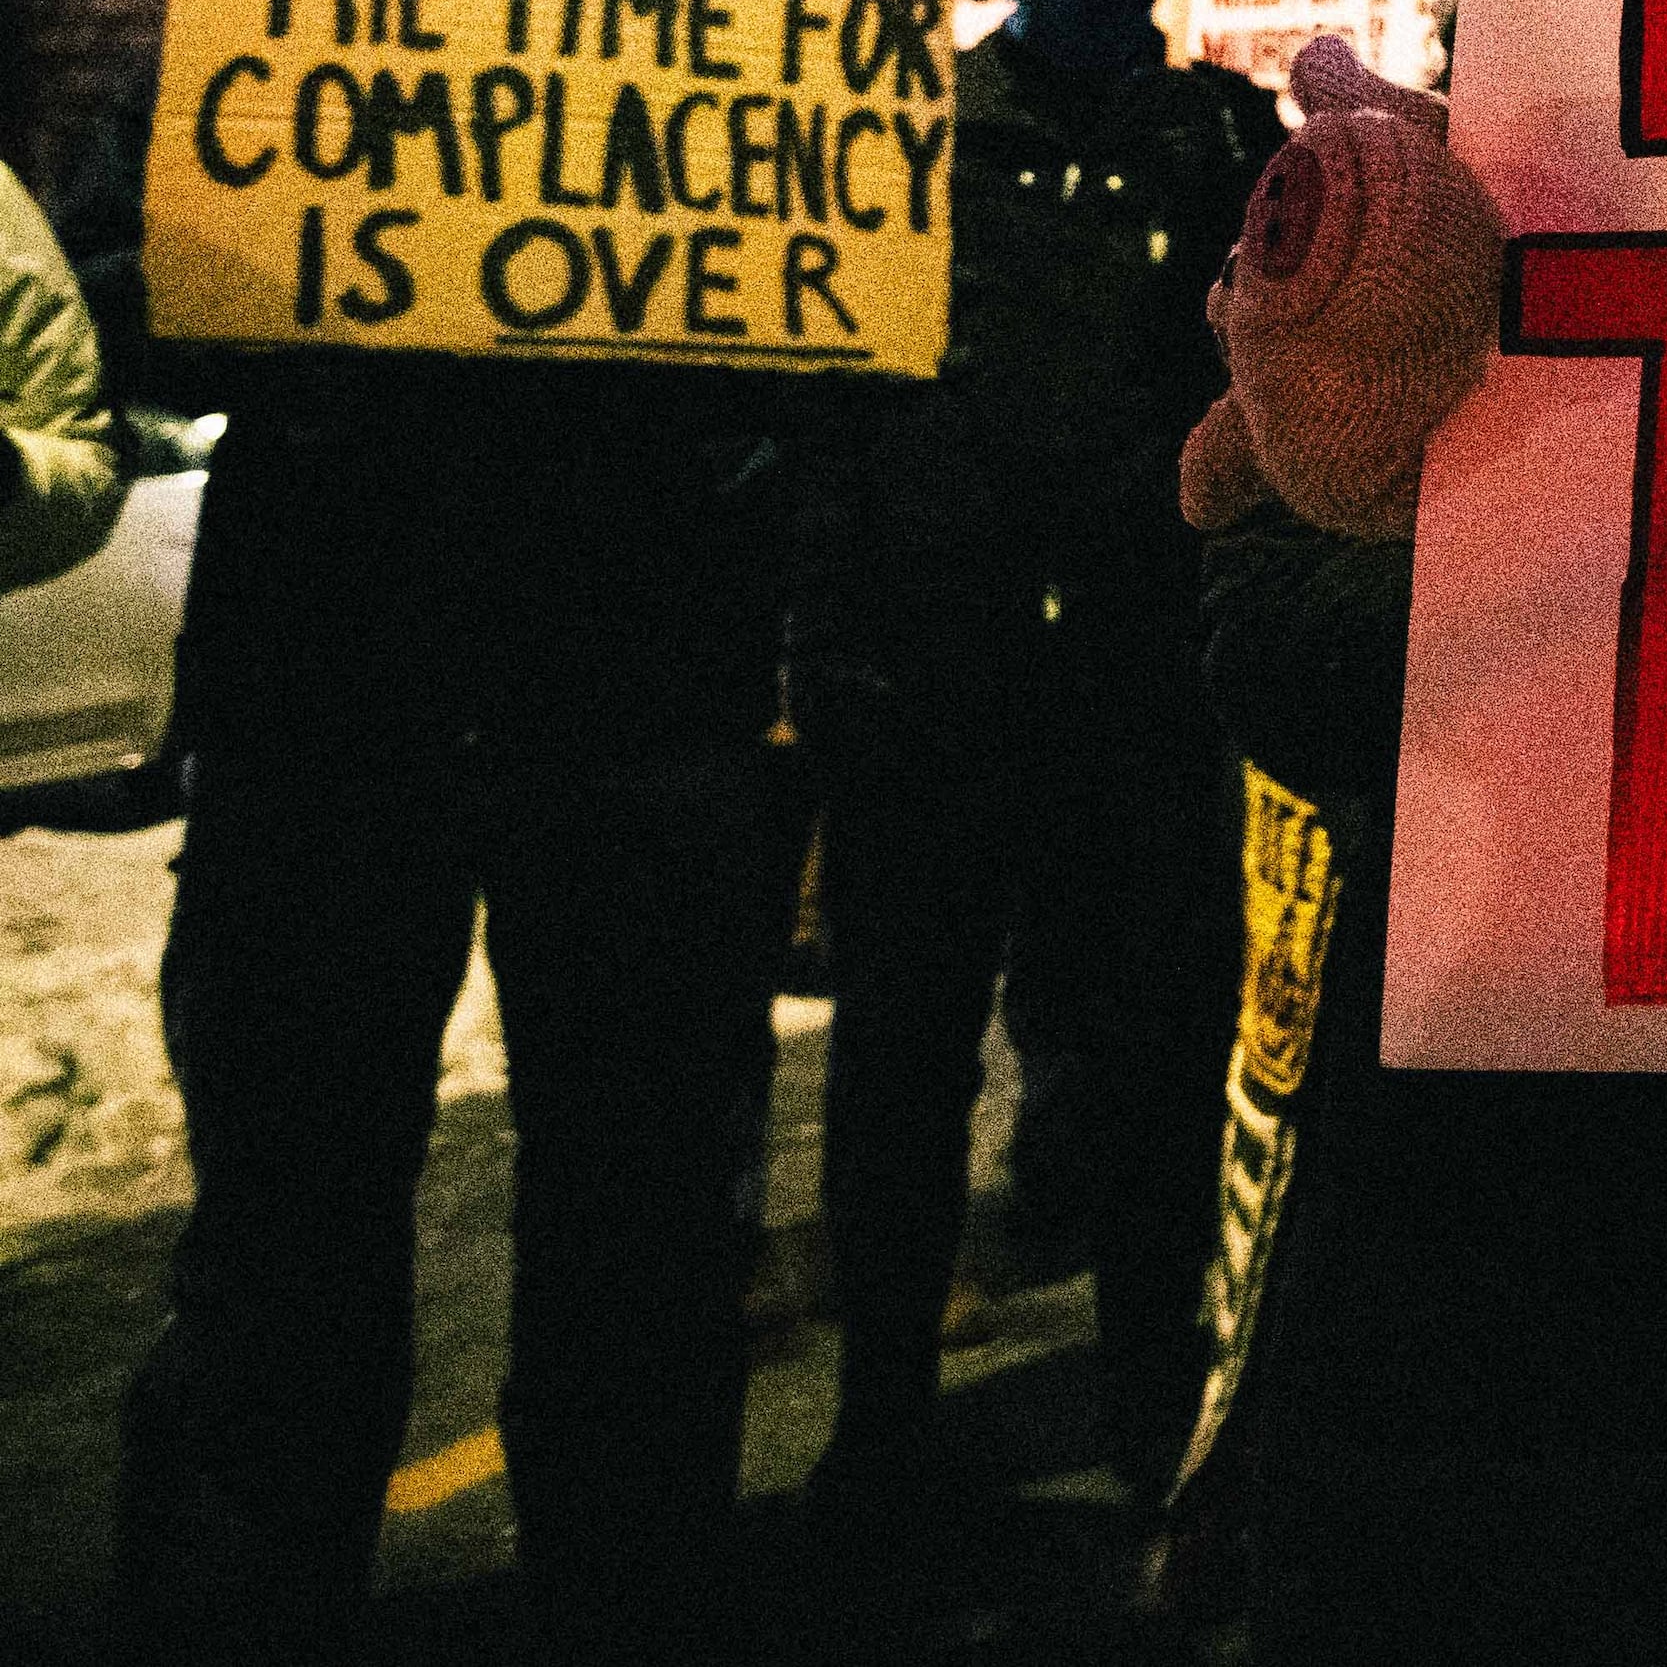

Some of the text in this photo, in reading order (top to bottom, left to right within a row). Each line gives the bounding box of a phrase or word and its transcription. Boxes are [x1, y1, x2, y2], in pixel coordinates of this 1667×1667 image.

[193, 53, 948, 236] COMPLACENCY
[292, 205, 859, 337] IS OVER
